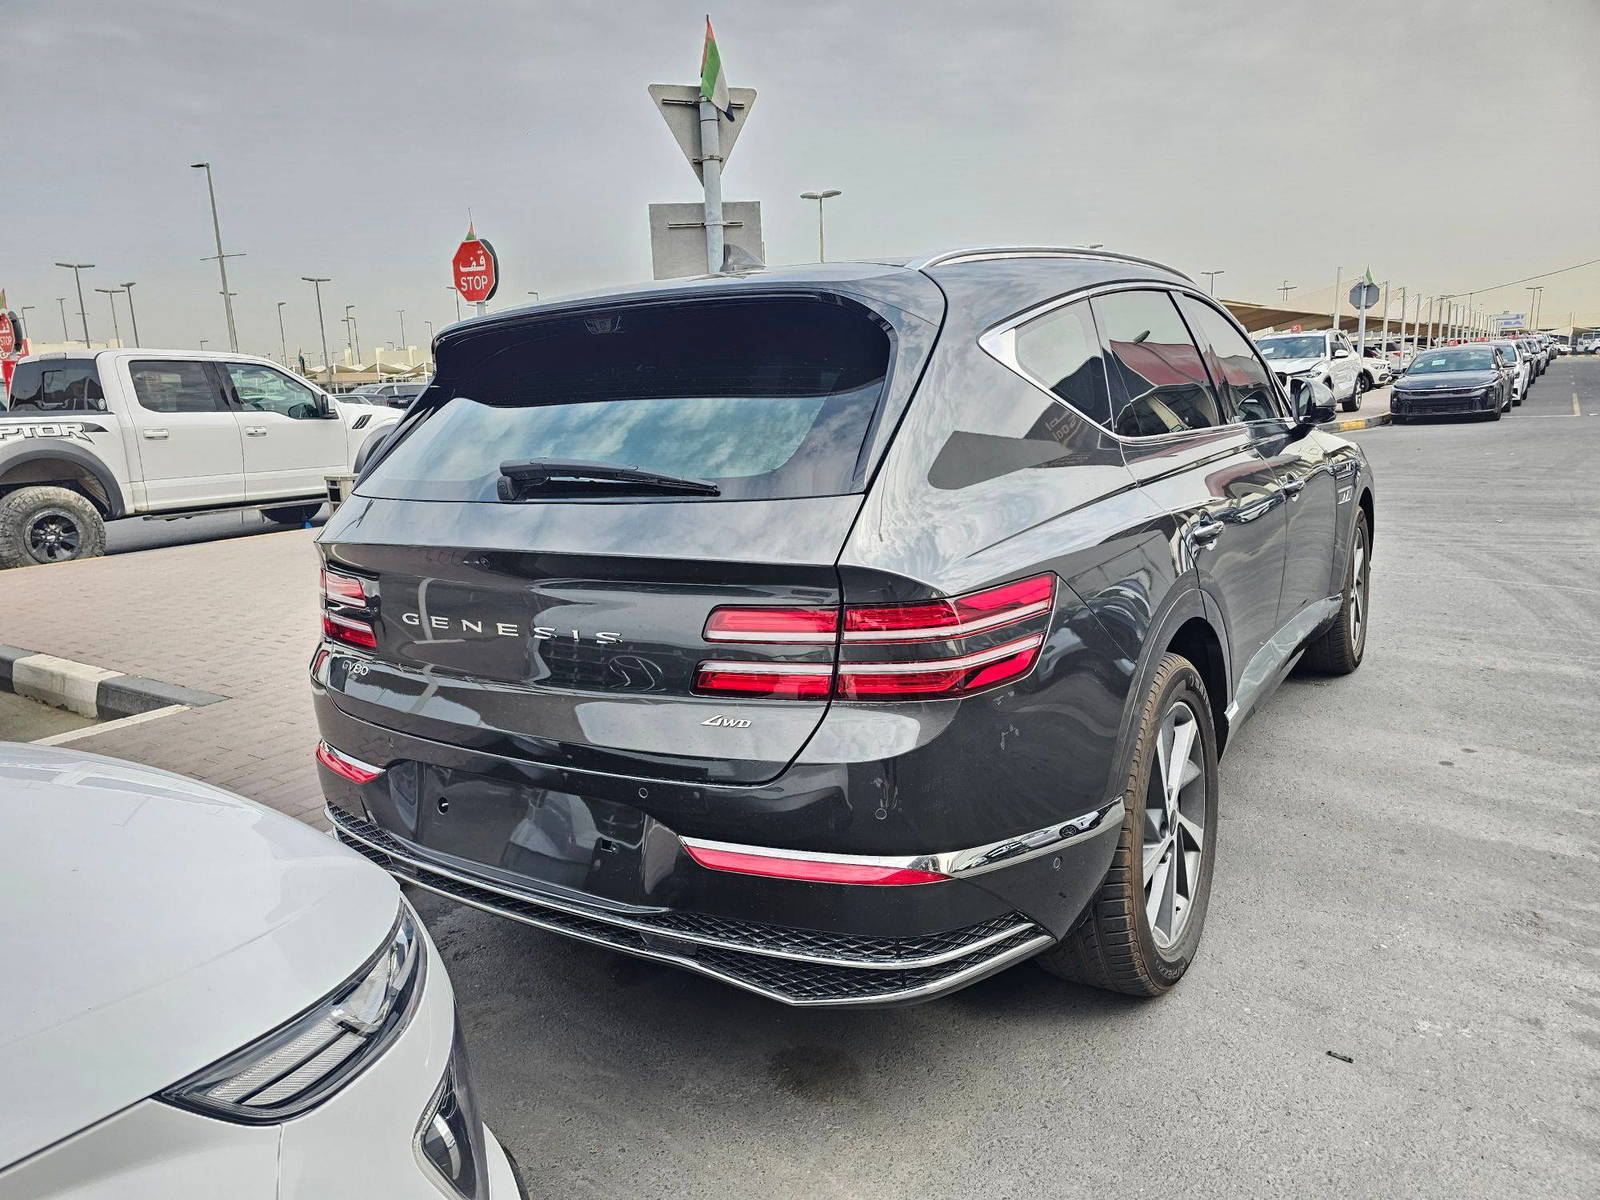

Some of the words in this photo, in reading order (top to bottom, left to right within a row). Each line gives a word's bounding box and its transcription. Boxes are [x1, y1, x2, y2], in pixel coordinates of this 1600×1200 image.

[460, 246, 486, 272] قف
[461, 276, 488, 291] STOP
[401, 612, 624, 645] GENESIS
[342, 660, 369, 676] GV80
[700, 714, 752, 728] 4WD
